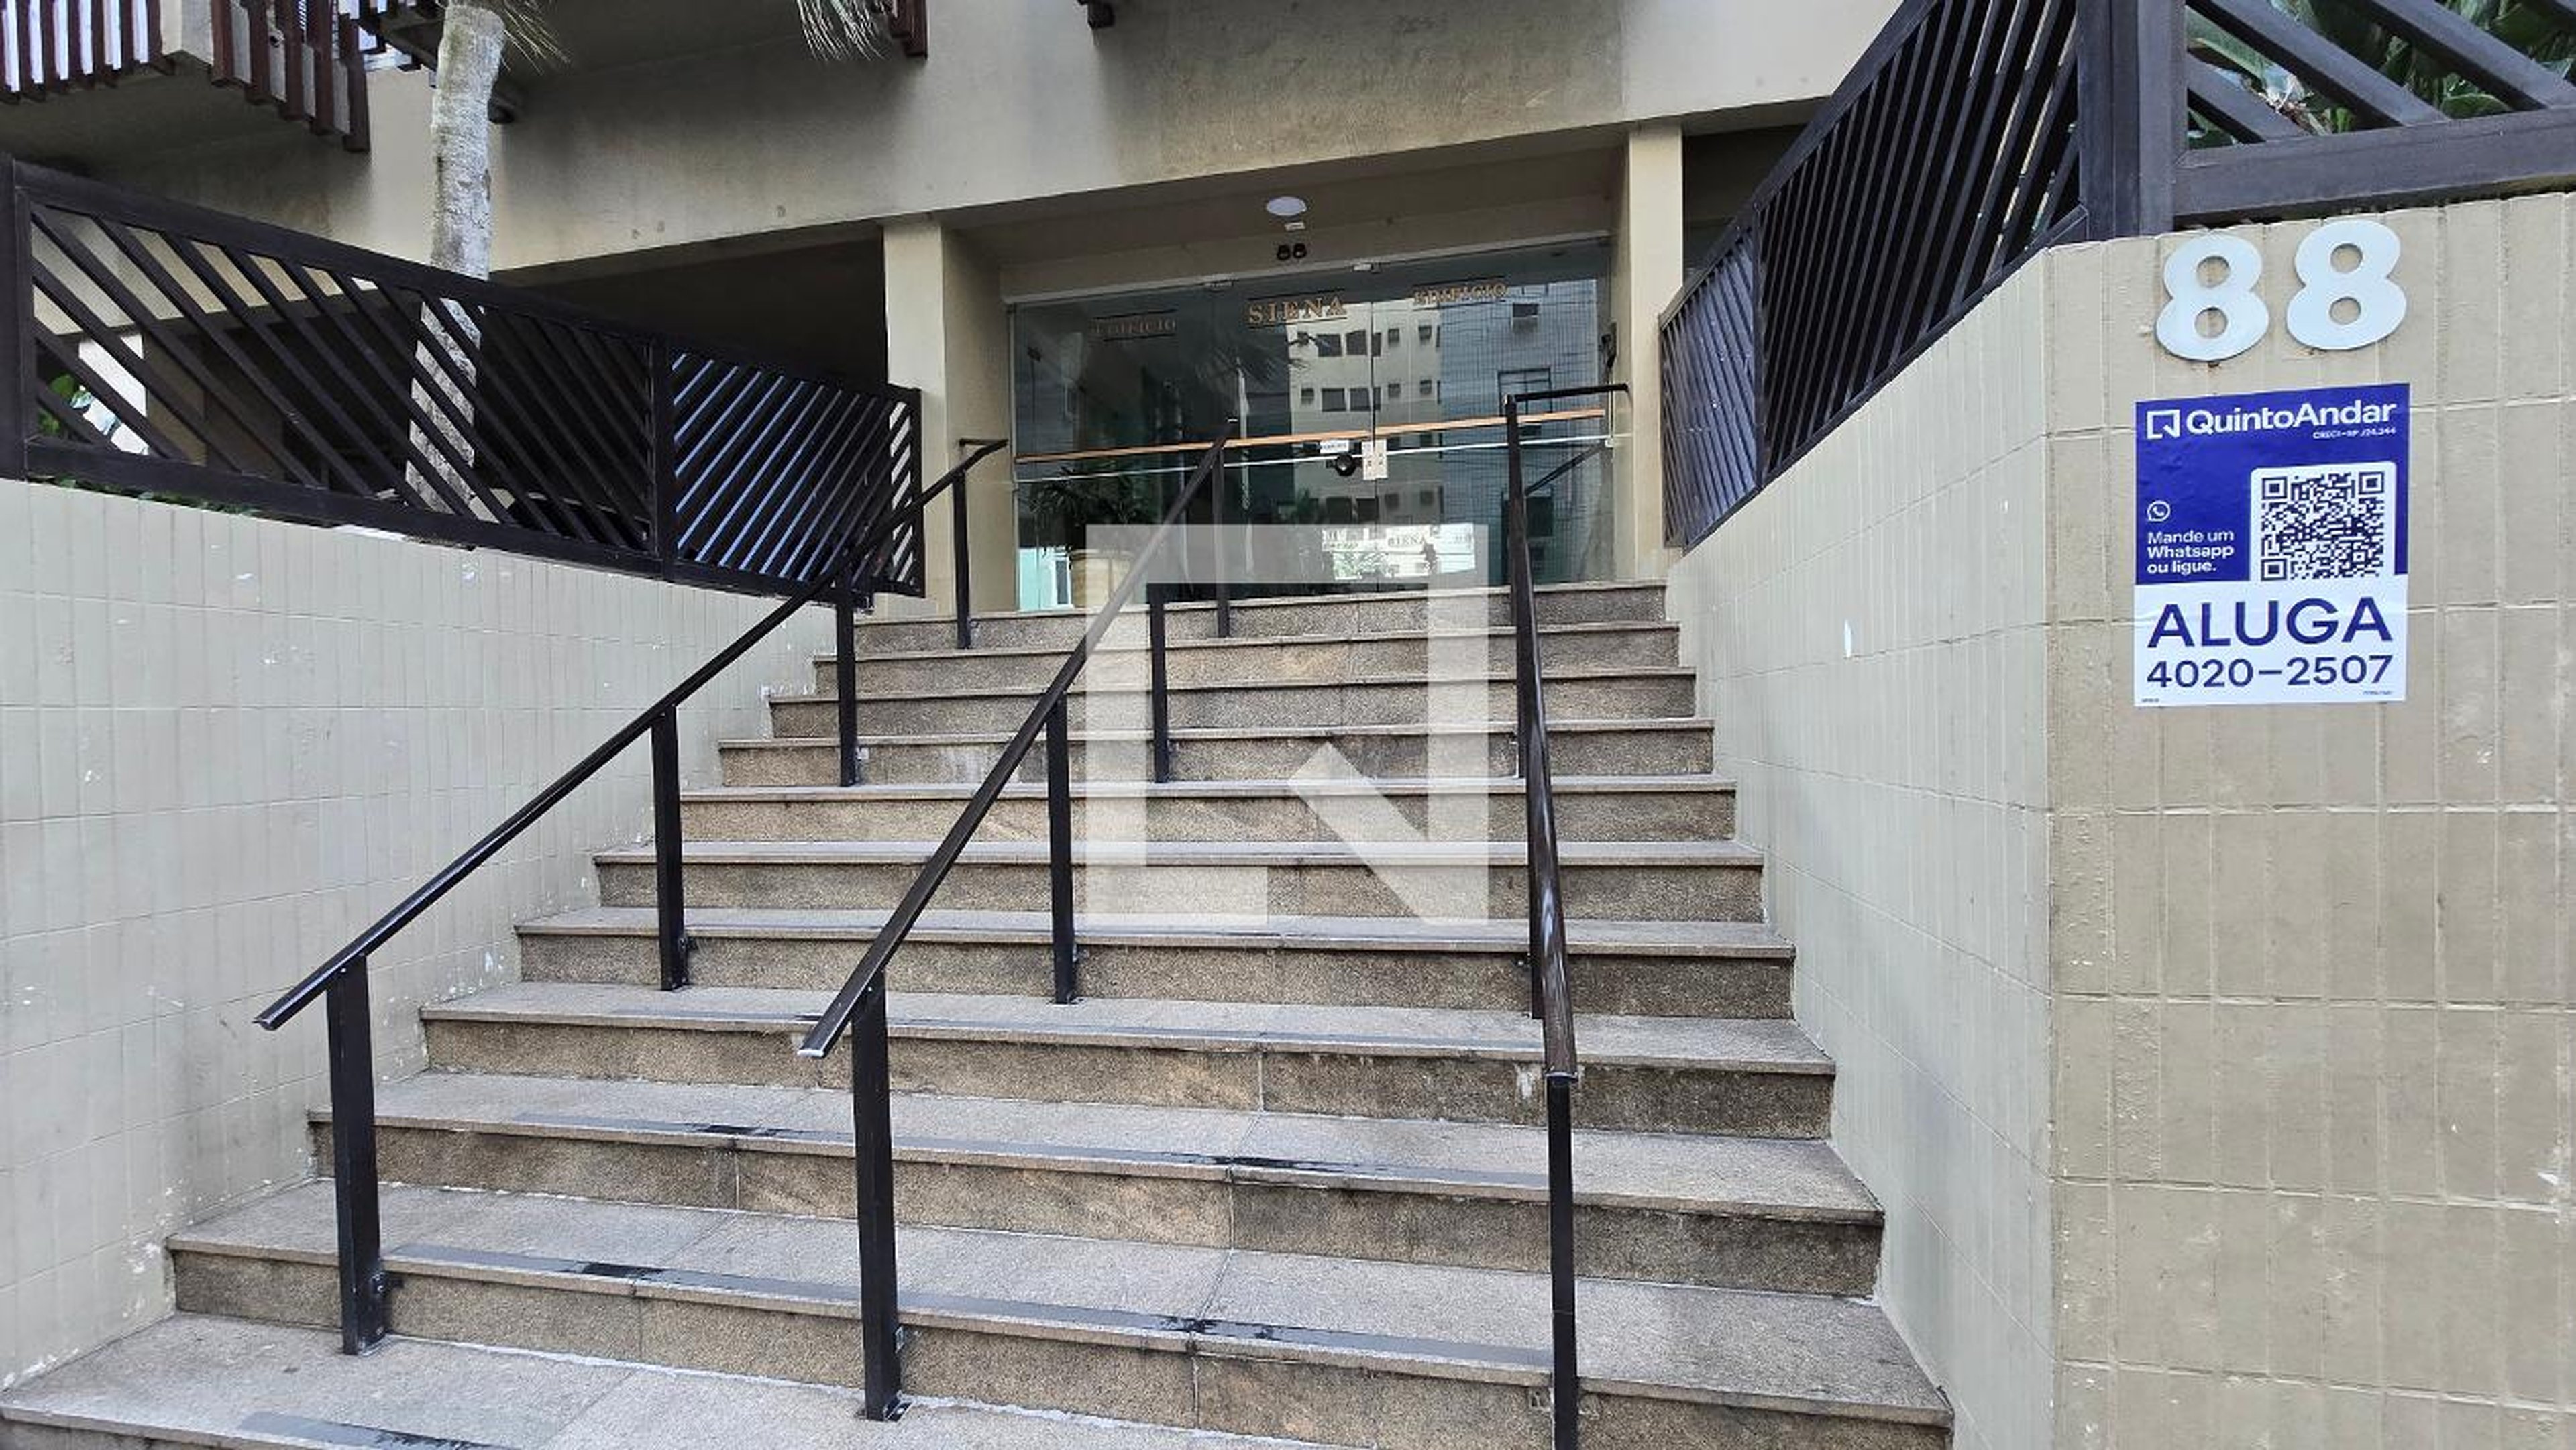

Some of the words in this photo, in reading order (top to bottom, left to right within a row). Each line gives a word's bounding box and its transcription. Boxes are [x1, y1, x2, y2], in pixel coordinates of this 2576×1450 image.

[1277, 243, 1307, 261] 88
[2155, 220, 2408, 361] 88
[1248, 295, 1347, 322] SIENA
[2186, 400, 2397, 435] QuintoAndar
[2147, 530, 2204, 545] Mande
[2207, 531, 2235, 542] um
[2147, 545, 2235, 559] Whatsapp
[2147, 563, 2168, 574] ou
[2172, 560, 2216, 576] ligue.
[2147, 596, 2393, 649] ALUGA
[2147, 655, 2393, 688] 4020-2507
